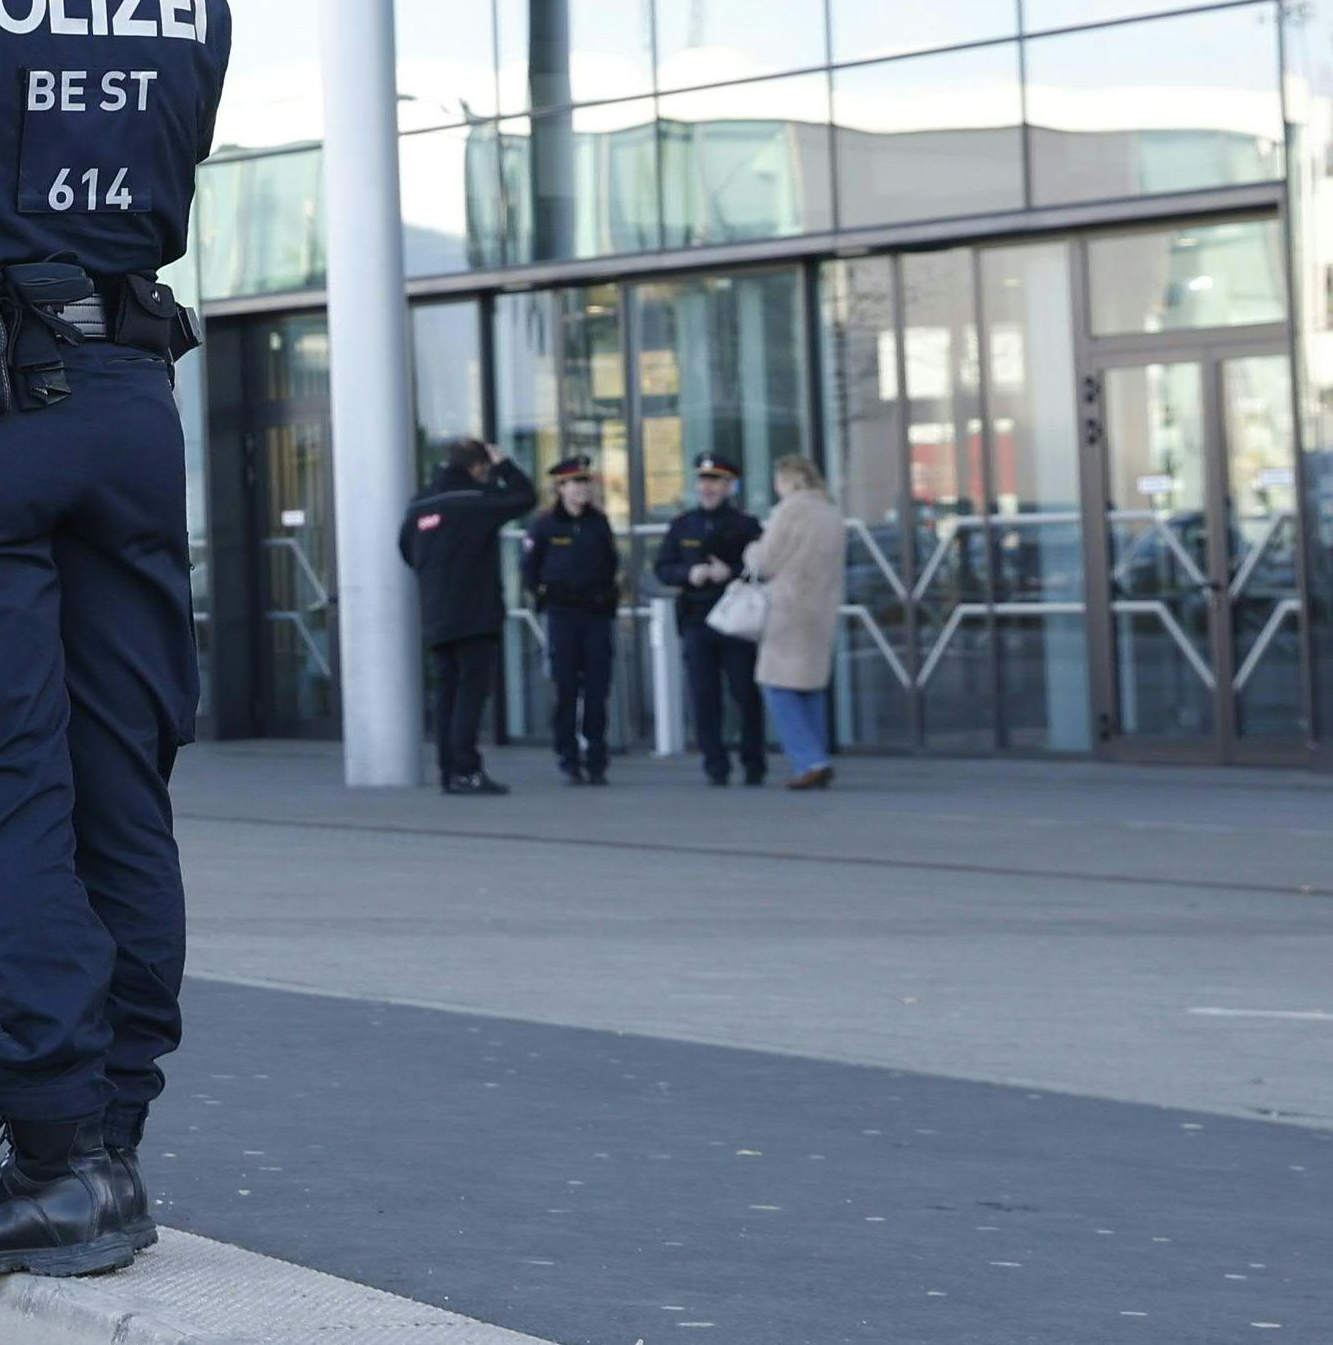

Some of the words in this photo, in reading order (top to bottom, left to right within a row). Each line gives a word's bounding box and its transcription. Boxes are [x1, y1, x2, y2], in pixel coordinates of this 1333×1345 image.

[27, 70, 87, 111] BE
[99, 70, 158, 111] ST
[47, 167, 133, 211] 614
